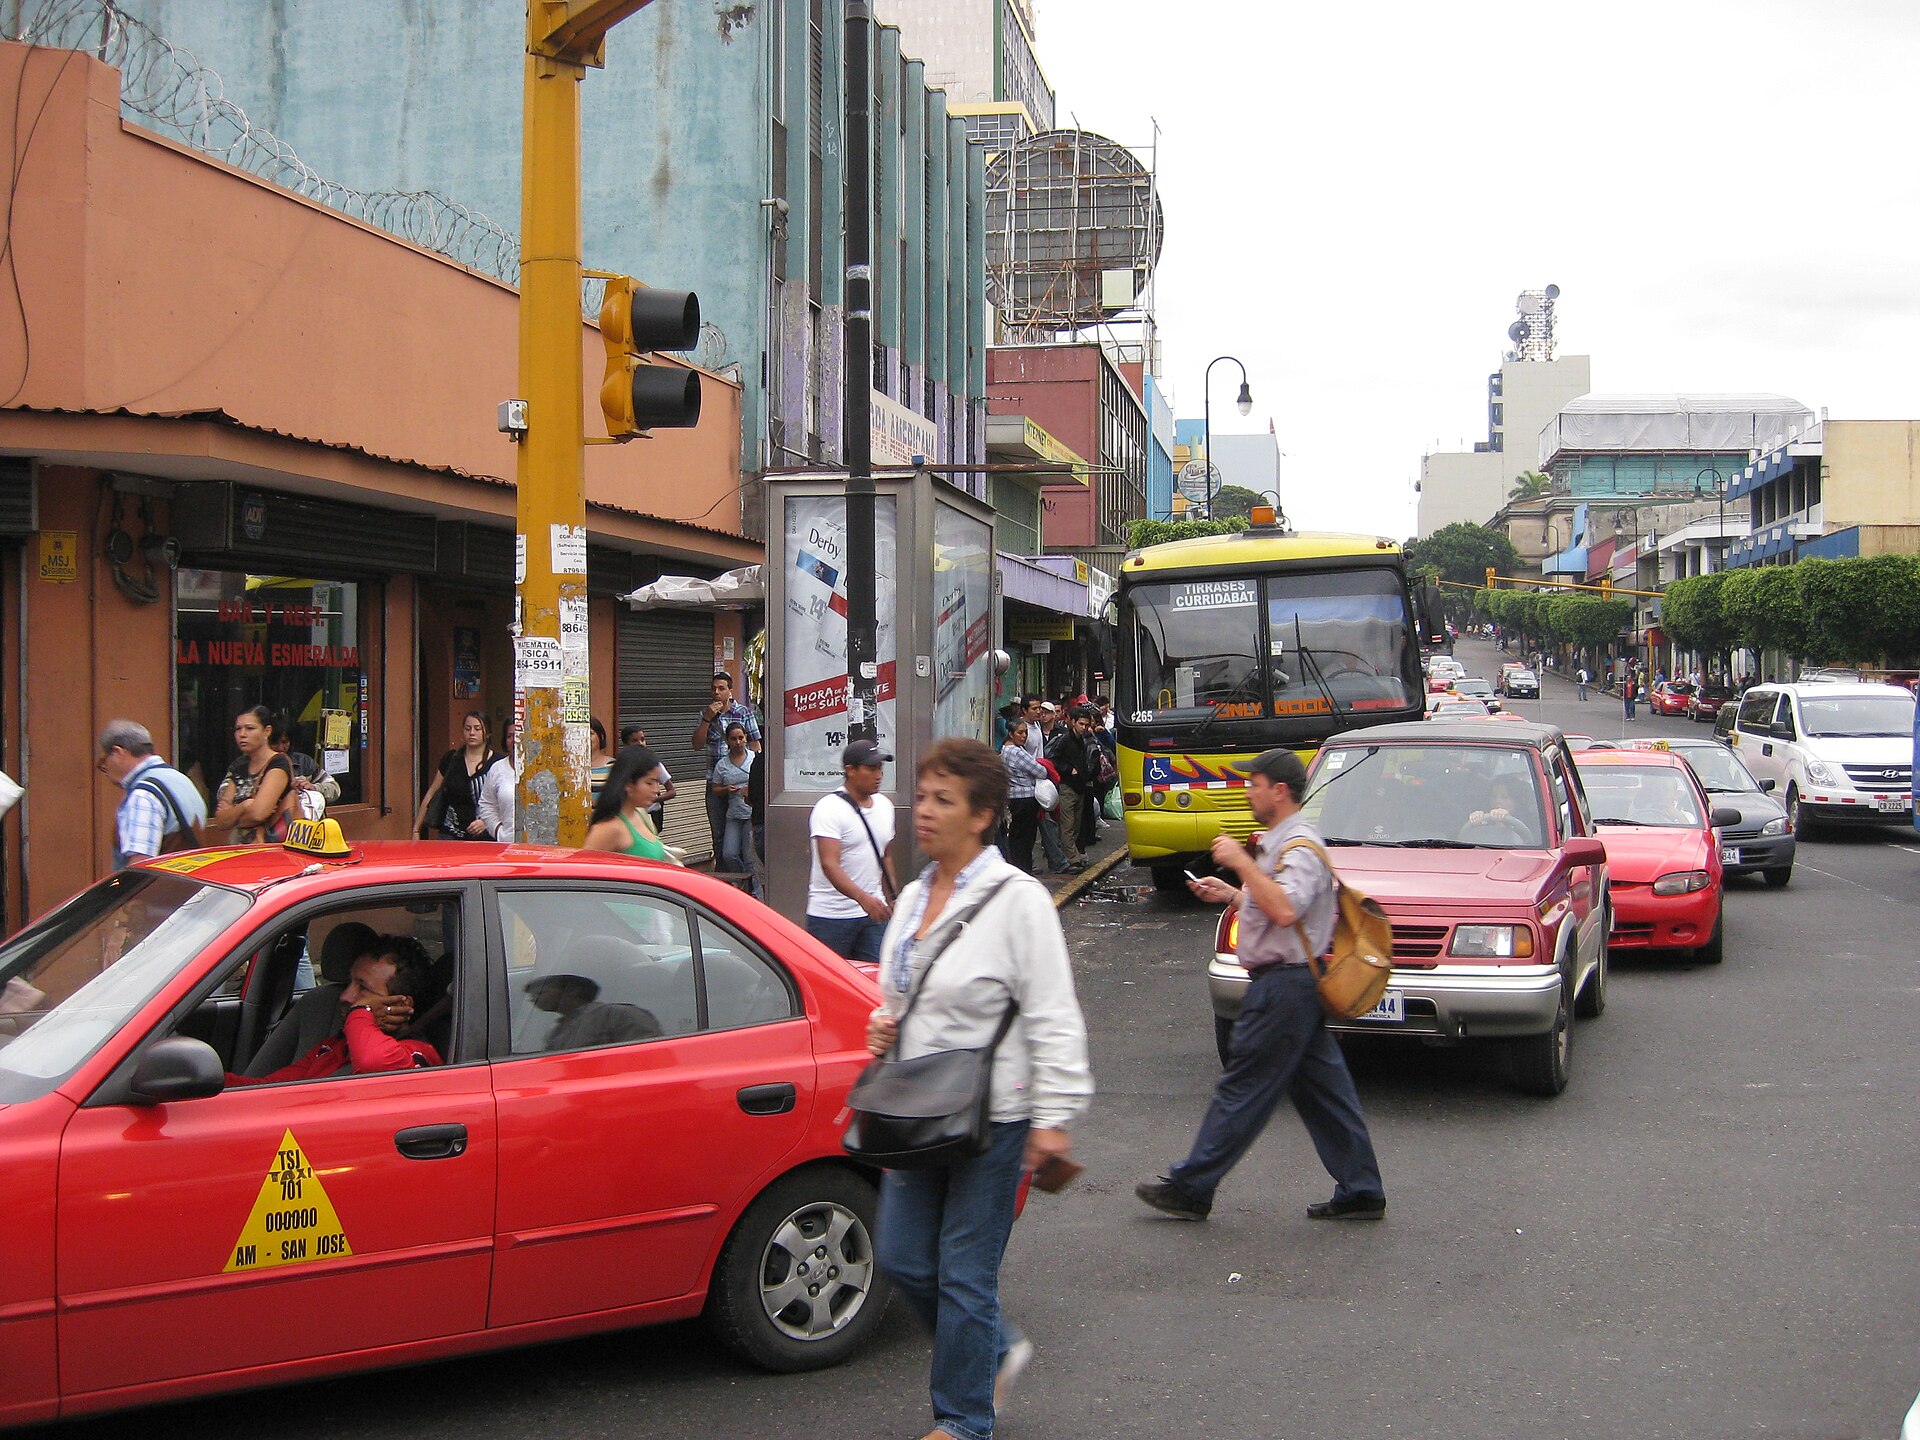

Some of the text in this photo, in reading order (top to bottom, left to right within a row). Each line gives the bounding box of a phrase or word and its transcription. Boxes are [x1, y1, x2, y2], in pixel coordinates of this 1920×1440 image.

[809, 527, 842, 560] Derby
[47, 555, 69, 567] MSJ
[1184, 580, 1246, 595] TIRRASES
[1175, 591, 1255, 607] CURRIDABAT
[218, 600, 325, 627] BAR Y REST.
[177, 639, 360, 668] LA NUEVA ESMERALDA
[799, 687, 834, 704] HORA
[808, 702, 817, 710] ES
[1216, 697, 1332, 718] ONLY GOOD
[287, 822, 313, 845] TAXI
[278, 1149, 301, 1170] TSJ
[281, 1179, 302, 1200] 701
[235, 1245, 257, 1267] AM
[281, 1238, 307, 1260] SAN
[316, 1233, 345, 1255] JOSE
